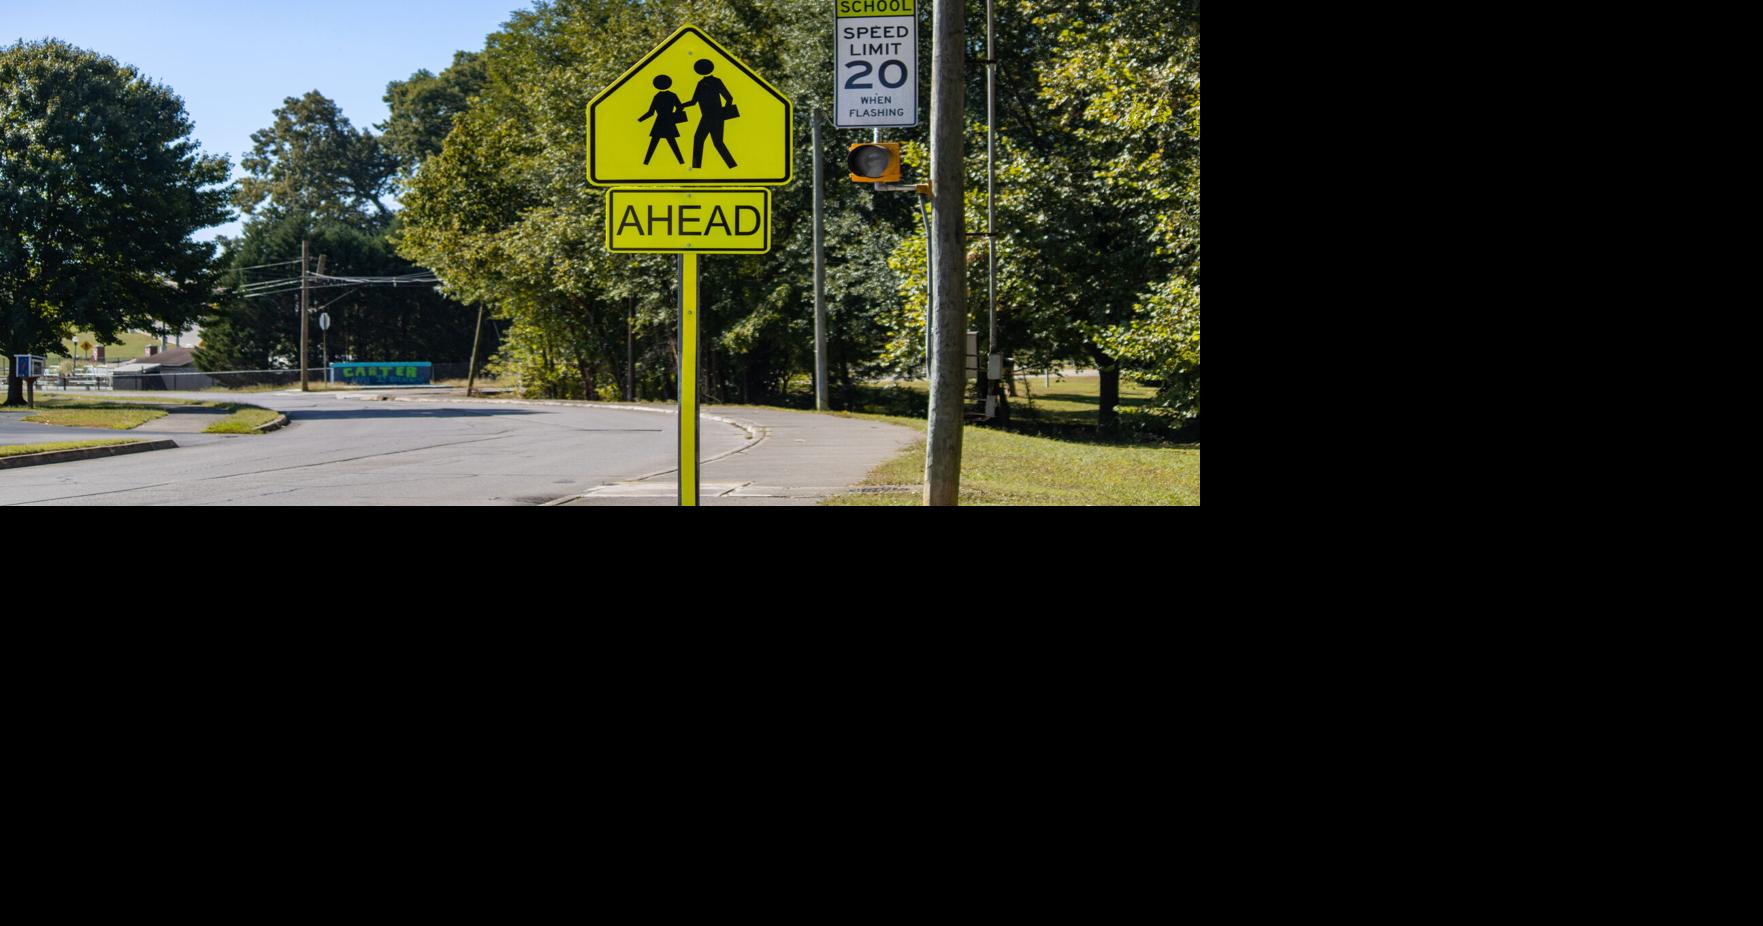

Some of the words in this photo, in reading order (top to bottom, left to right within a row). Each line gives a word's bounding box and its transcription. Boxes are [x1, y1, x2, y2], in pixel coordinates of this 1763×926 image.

[840, 0, 912, 13] SCHOOL
[843, 26, 909, 39] SPEED
[850, 43, 902, 56] LIMIT
[844, 59, 908, 89] 20
[860, 96, 892, 104] WHEN
[849, 108, 904, 117] FLASHING
[616, 205, 761, 236] AHEAD
[342, 366, 417, 378] CARTER
